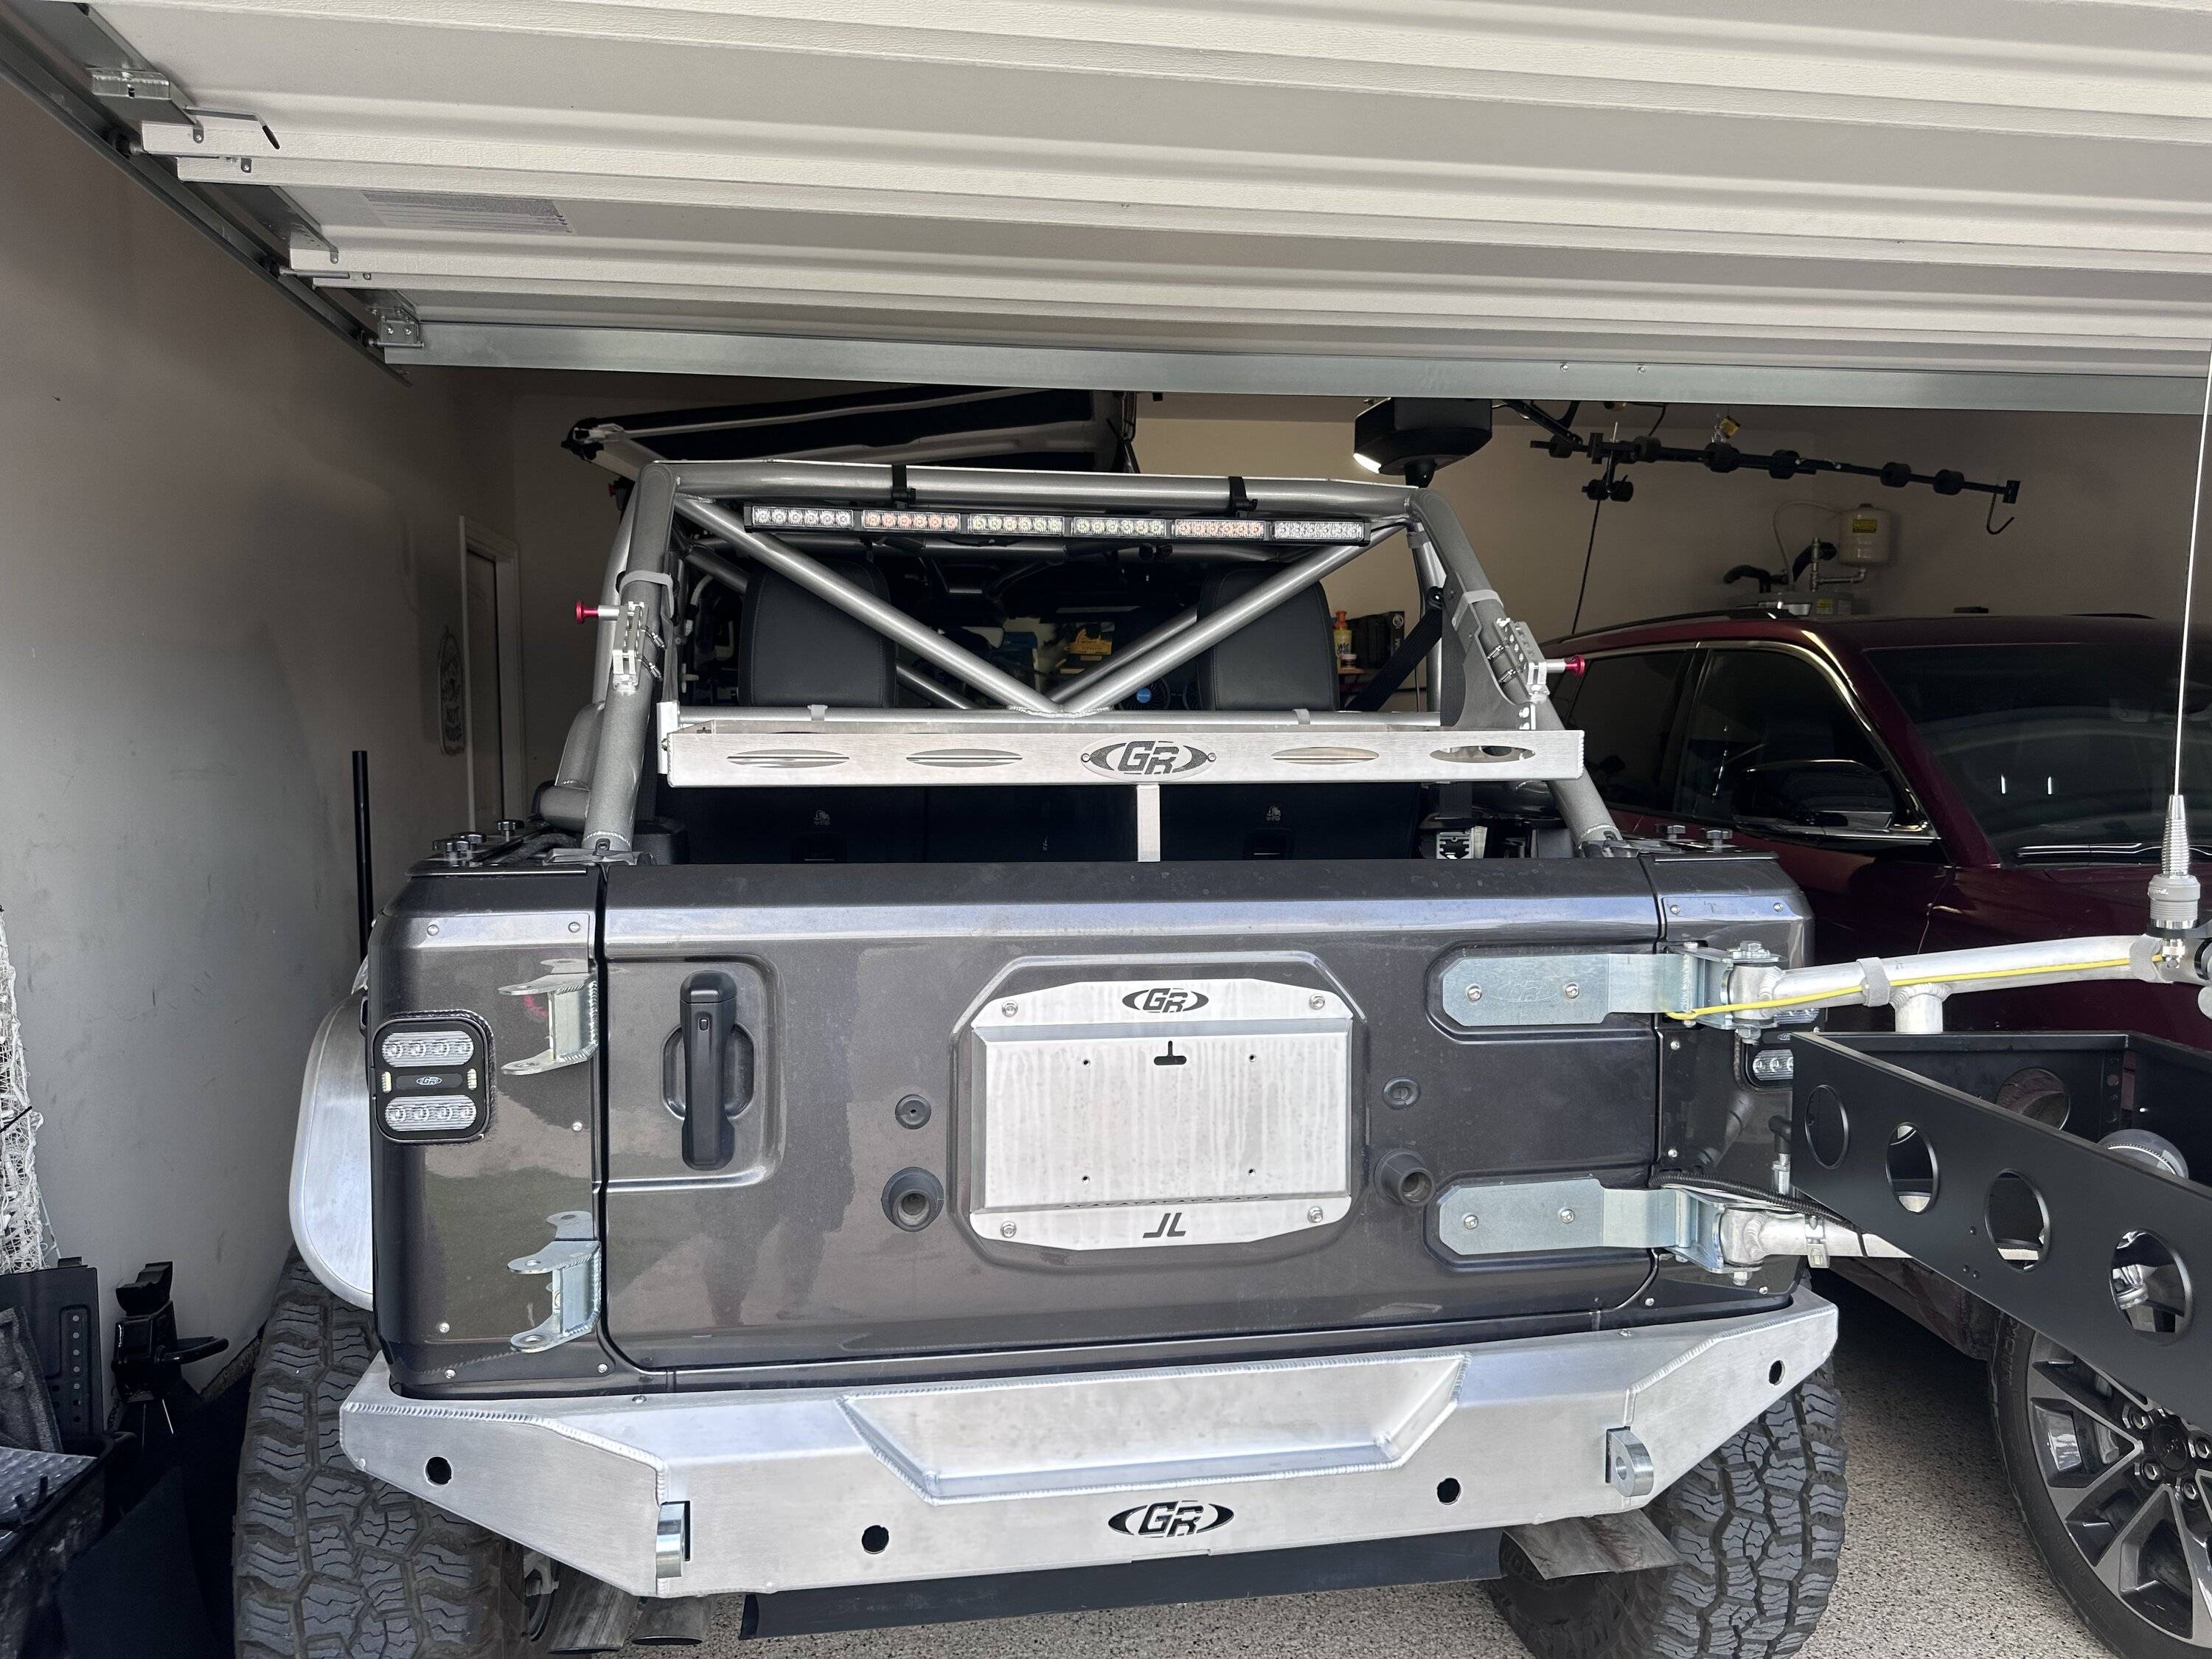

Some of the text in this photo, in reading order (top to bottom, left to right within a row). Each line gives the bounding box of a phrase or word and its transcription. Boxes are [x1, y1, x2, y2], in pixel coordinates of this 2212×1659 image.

[1118, 740, 1179, 774] GR
[1143, 988, 1189, 1012] GR
[1143, 1212, 1186, 1238] JL
[1138, 1500, 1204, 1537] GR
